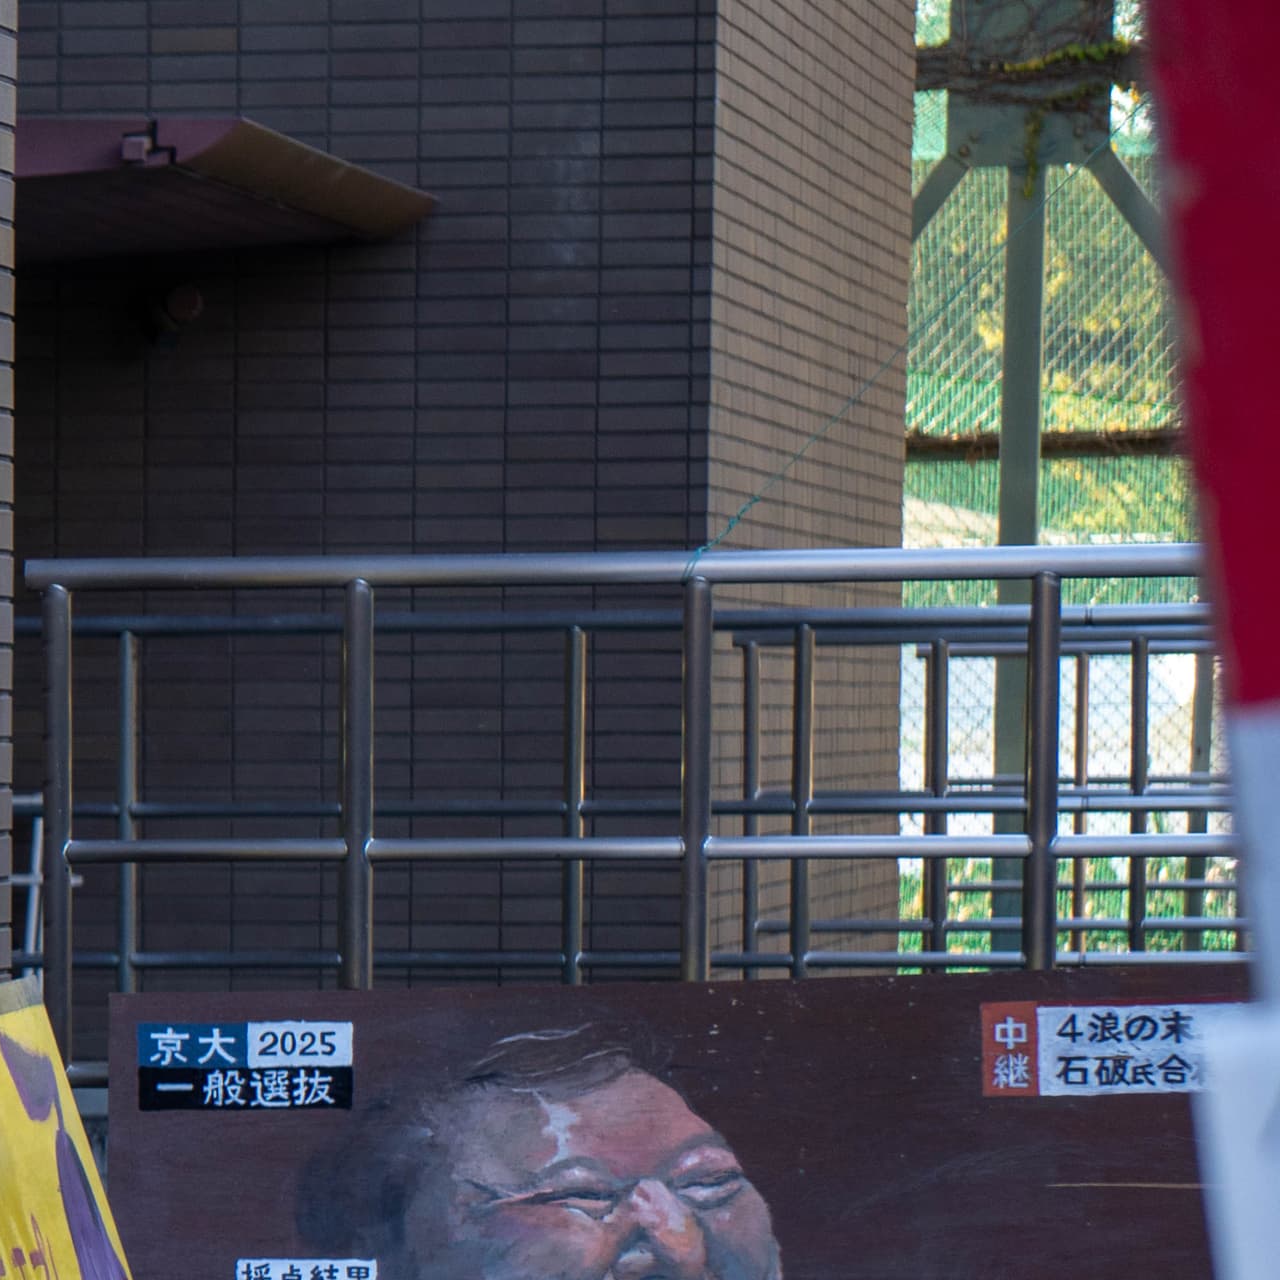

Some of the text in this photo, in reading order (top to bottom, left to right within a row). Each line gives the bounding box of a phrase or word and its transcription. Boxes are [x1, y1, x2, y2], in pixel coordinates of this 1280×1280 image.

[150, 1027, 336, 1065] 京大 2025
[1056, 1011, 1195, 1044] 4浪の末
[994, 1017, 1031, 1089] 中継
[156, 1070, 335, 1109] 一般選抜
